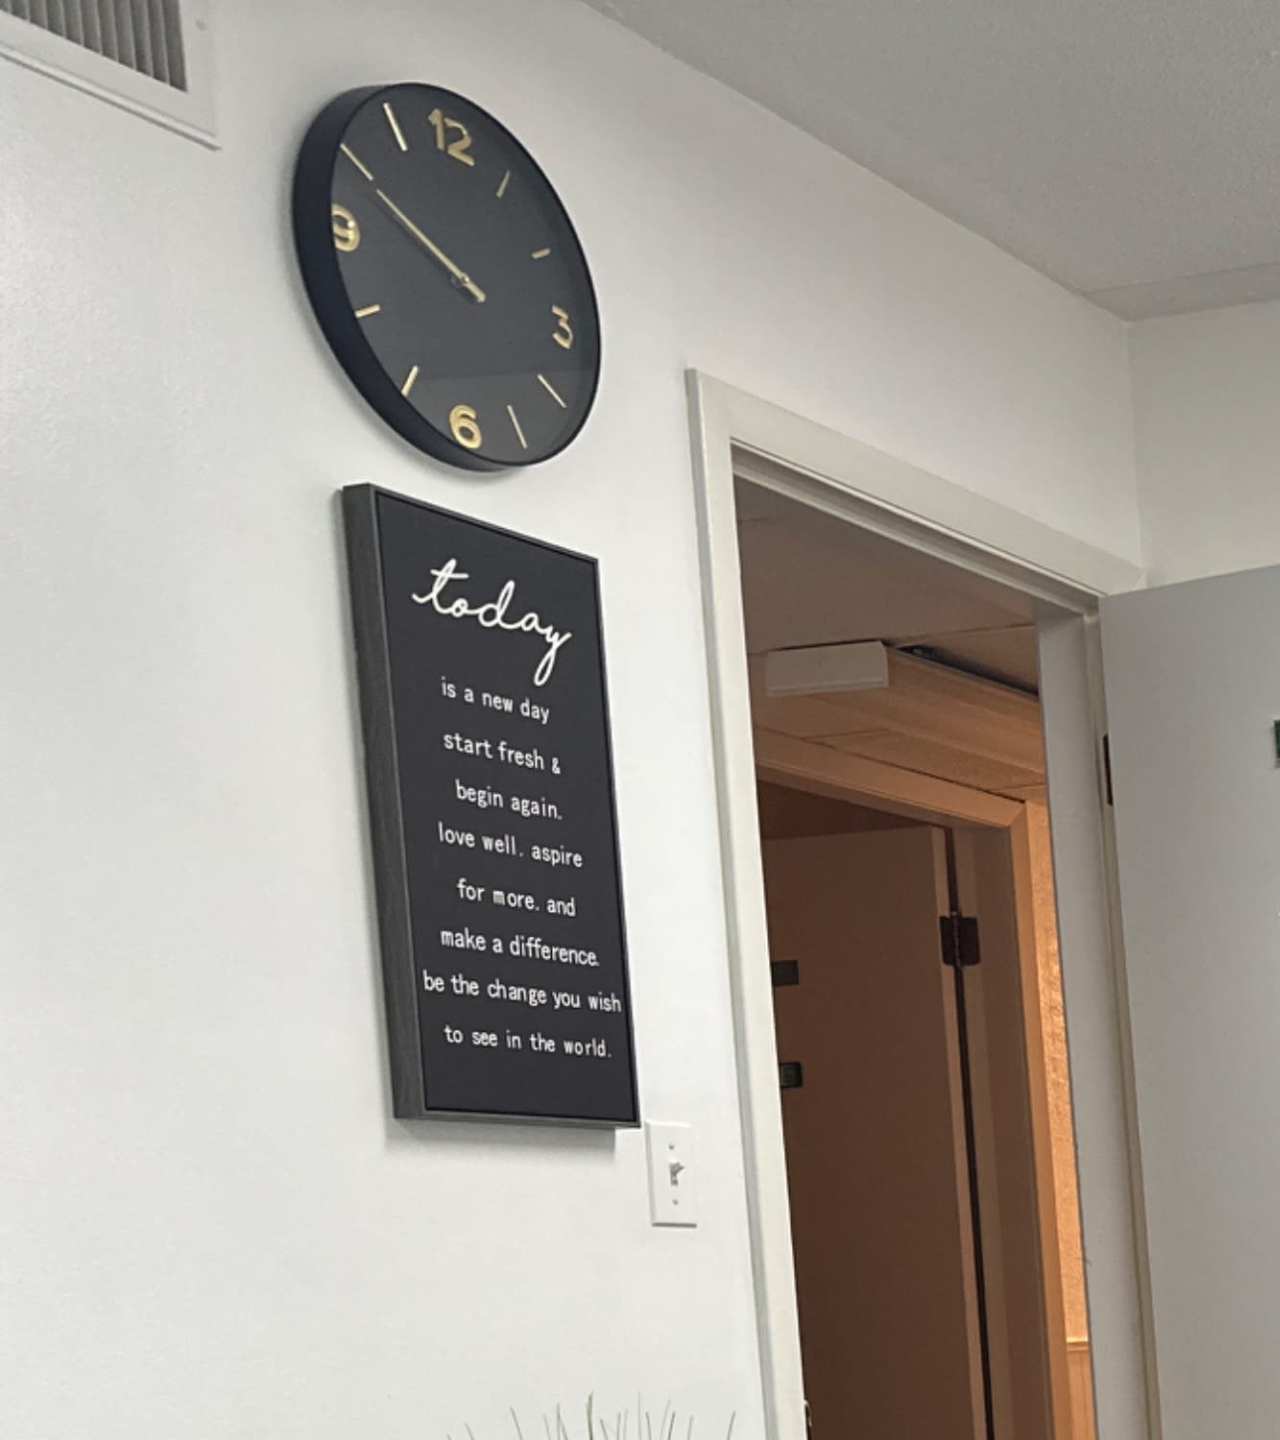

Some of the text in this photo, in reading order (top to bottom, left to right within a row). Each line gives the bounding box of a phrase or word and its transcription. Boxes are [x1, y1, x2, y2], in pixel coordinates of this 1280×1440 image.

[428, 108, 475, 166] 12
[332, 203, 361, 252] 9
[552, 305, 573, 349] 3
[448, 405, 482, 449] 6
[412, 558, 572, 686] today
[441, 676, 549, 725] is a new day
[443, 733, 561, 774] start fresh &
[455, 779, 563, 820] begin again.
[438, 821, 475, 848] love
[531, 845, 583, 868] aspire
[456, 878, 485, 901] for
[547, 897, 576, 917] and
[440, 927, 600, 967] make a difference.
[423, 969, 622, 1013] be the change you wish
[444, 1025, 612, 1058] to see in the world.
